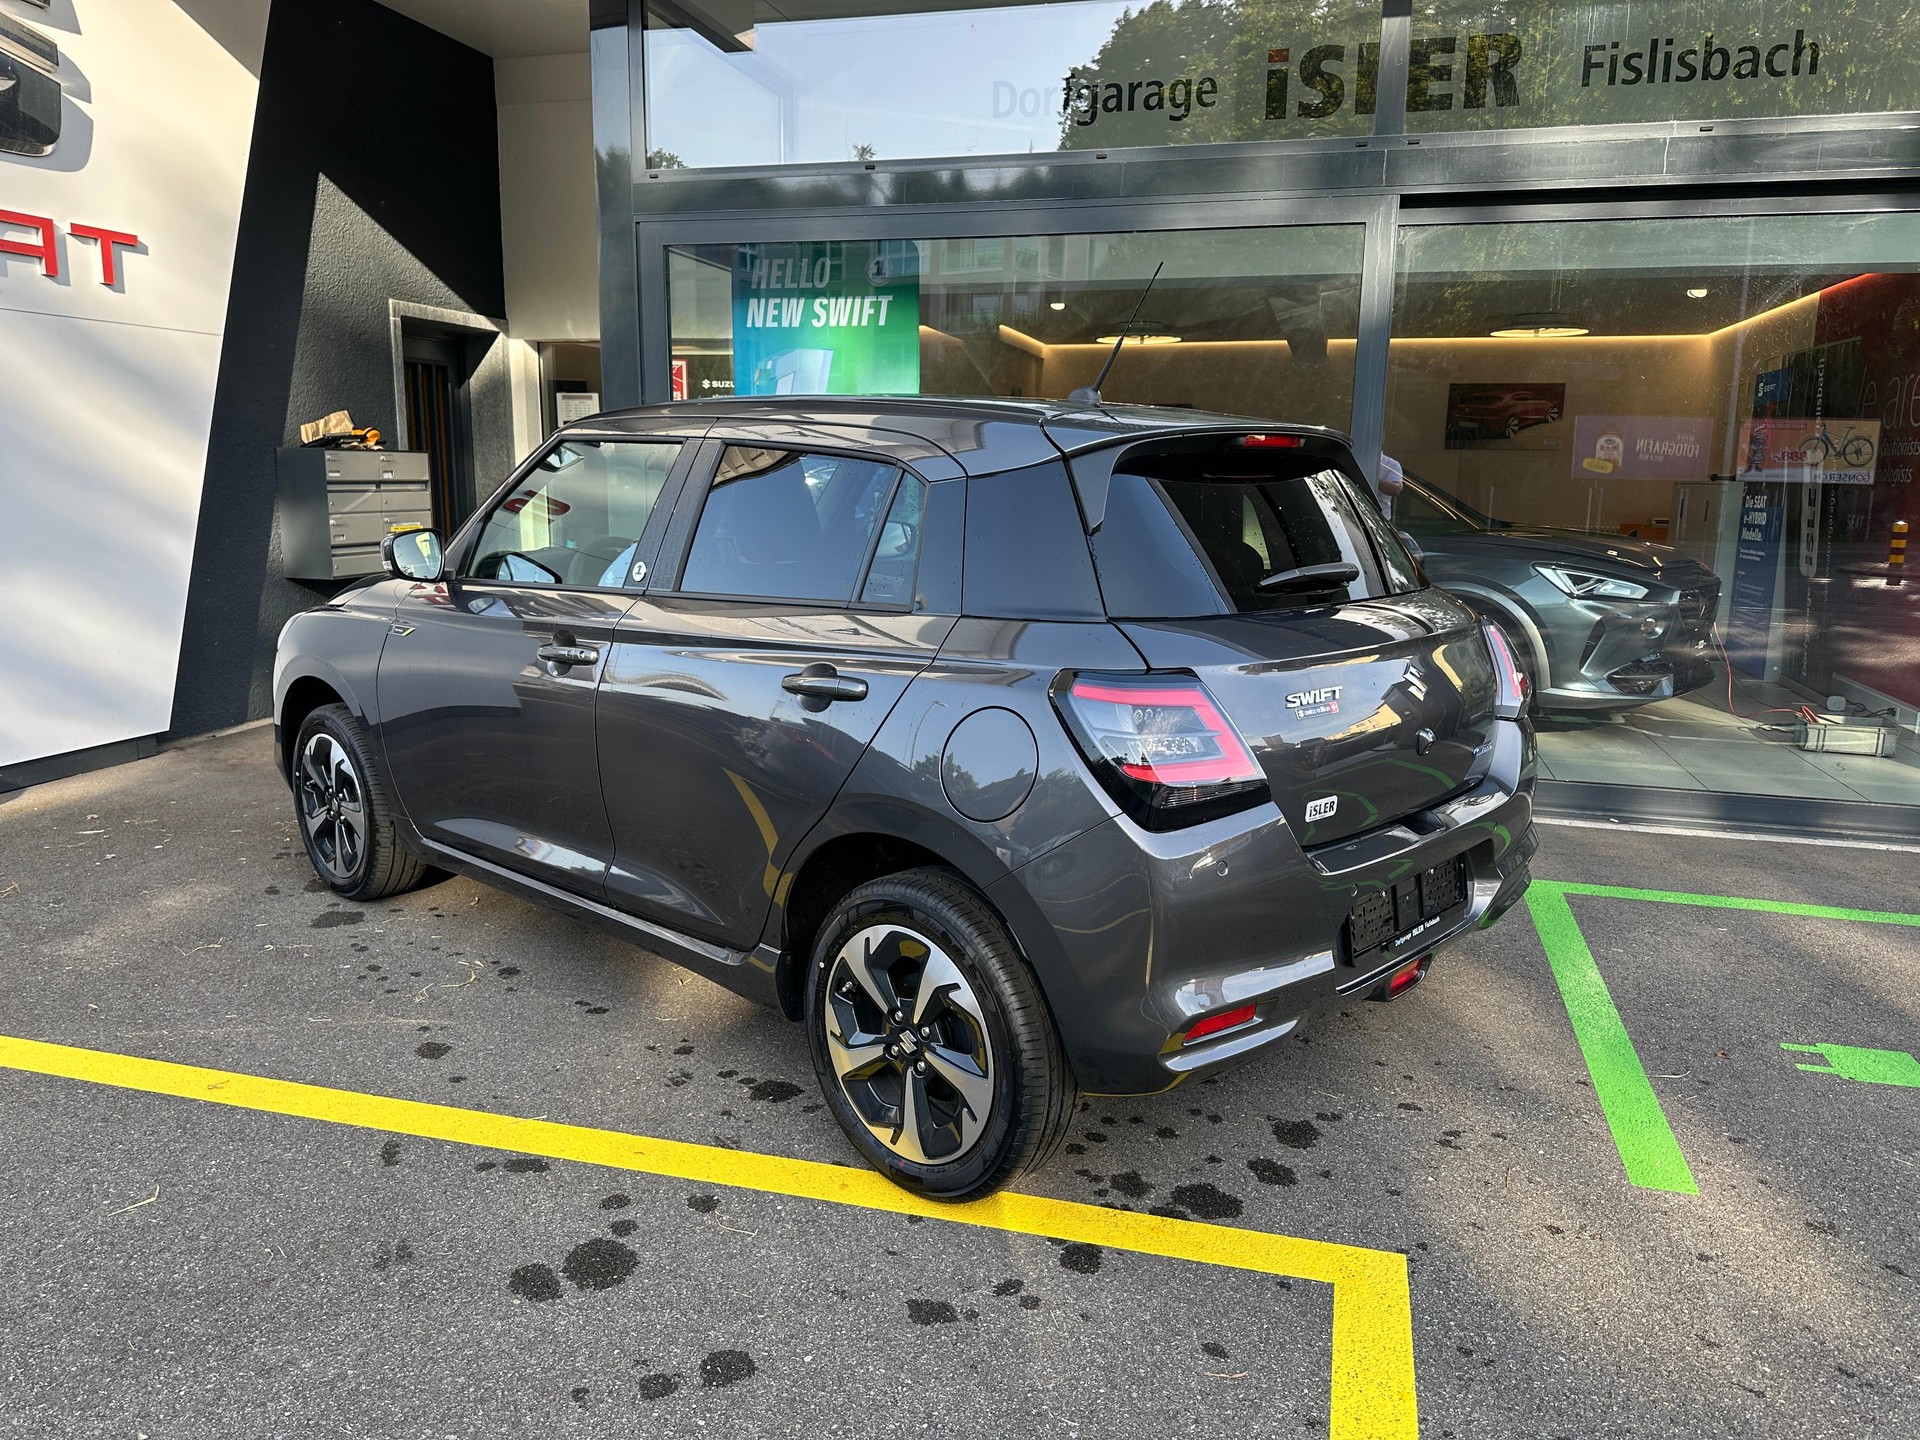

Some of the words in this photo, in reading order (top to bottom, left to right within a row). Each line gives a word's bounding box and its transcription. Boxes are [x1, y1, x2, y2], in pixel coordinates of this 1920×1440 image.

[992, 72, 1218, 127] Dorfgarage
[1581, 29, 1820, 89] Fislisbach
[0, 209, 138, 285] AT
[751, 257, 831, 289] HELLO
[746, 297, 804, 328] NEW
[811, 295, 893, 328] SWIFT
[711, 380, 735, 388] SUZU
[1754, 494, 1768, 508] SEAT
[1805, 488, 1817, 566] iSLE
[1285, 685, 1344, 709] SWIFT
